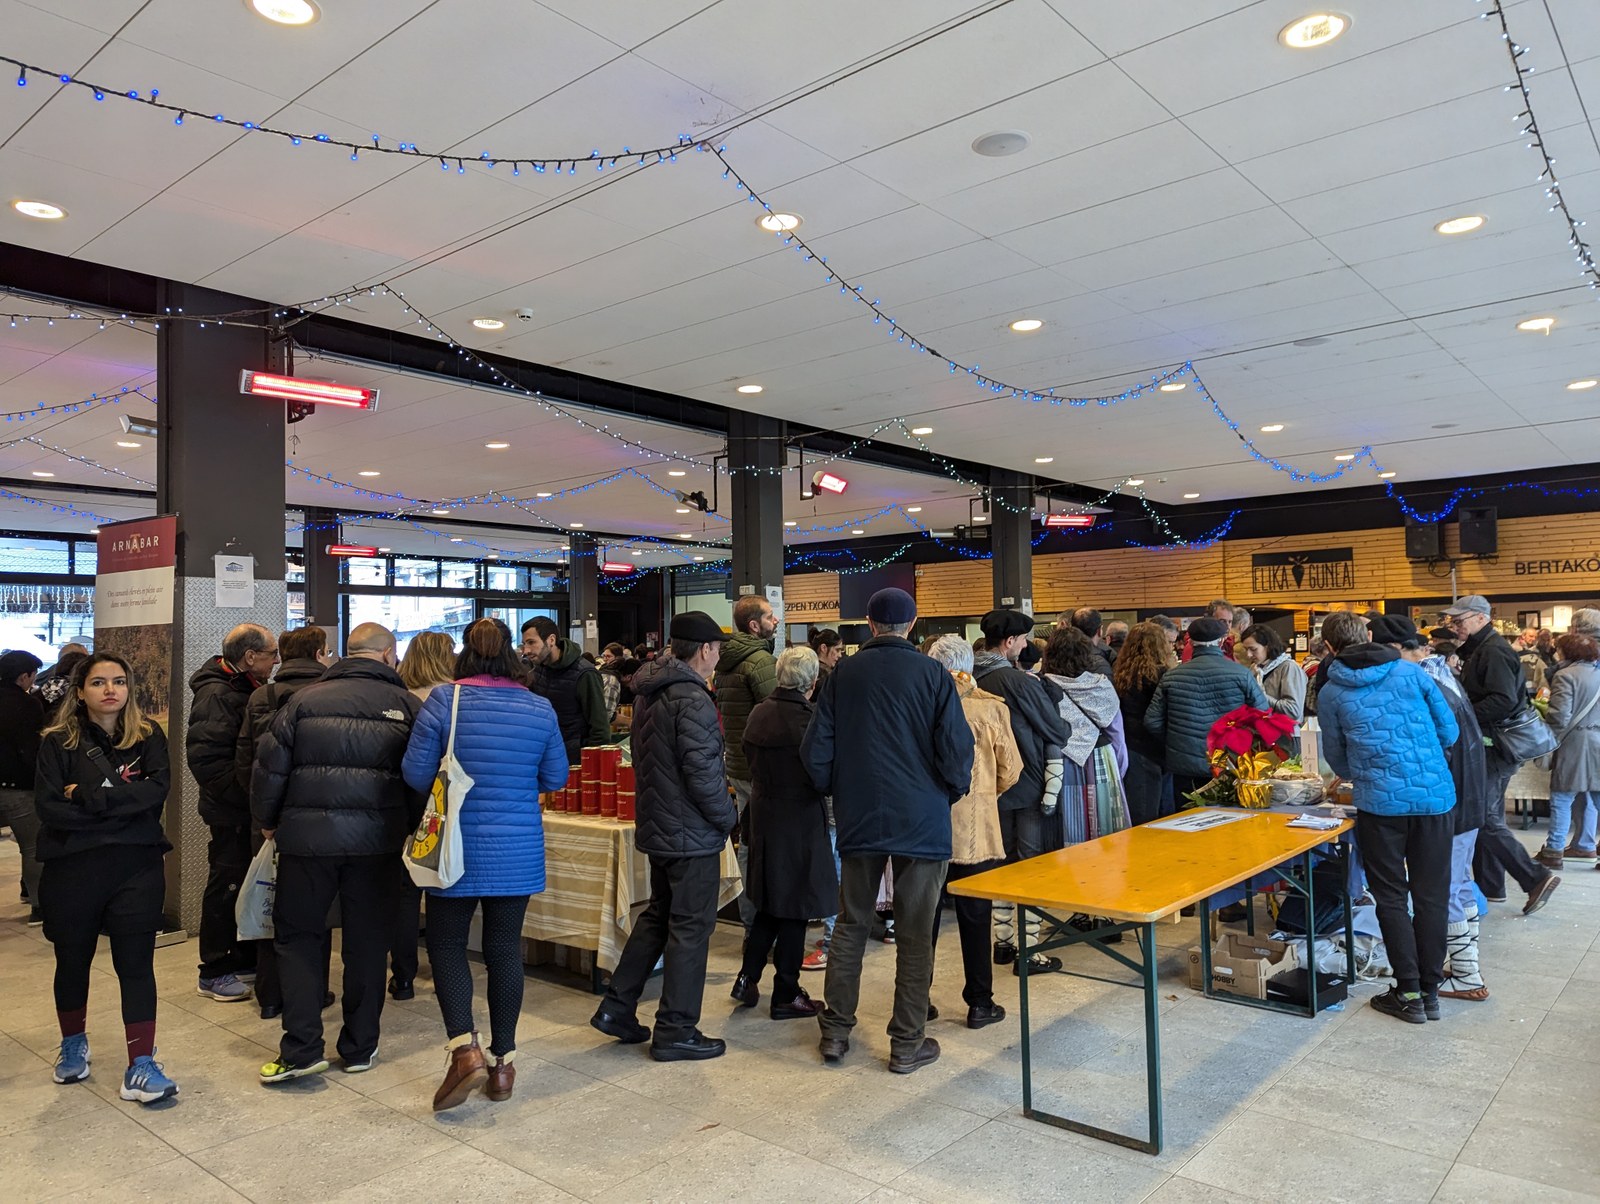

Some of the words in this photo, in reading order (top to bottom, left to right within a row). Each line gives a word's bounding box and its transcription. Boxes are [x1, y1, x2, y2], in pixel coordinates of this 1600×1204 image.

[112, 536, 159, 552] ARNABAR
[1515, 558, 1600, 576] BERTAKO
[1254, 565, 1289, 592] ELIKA
[1309, 562, 1352, 588] GUNEA
[808, 600, 840, 610] TXOKOA
